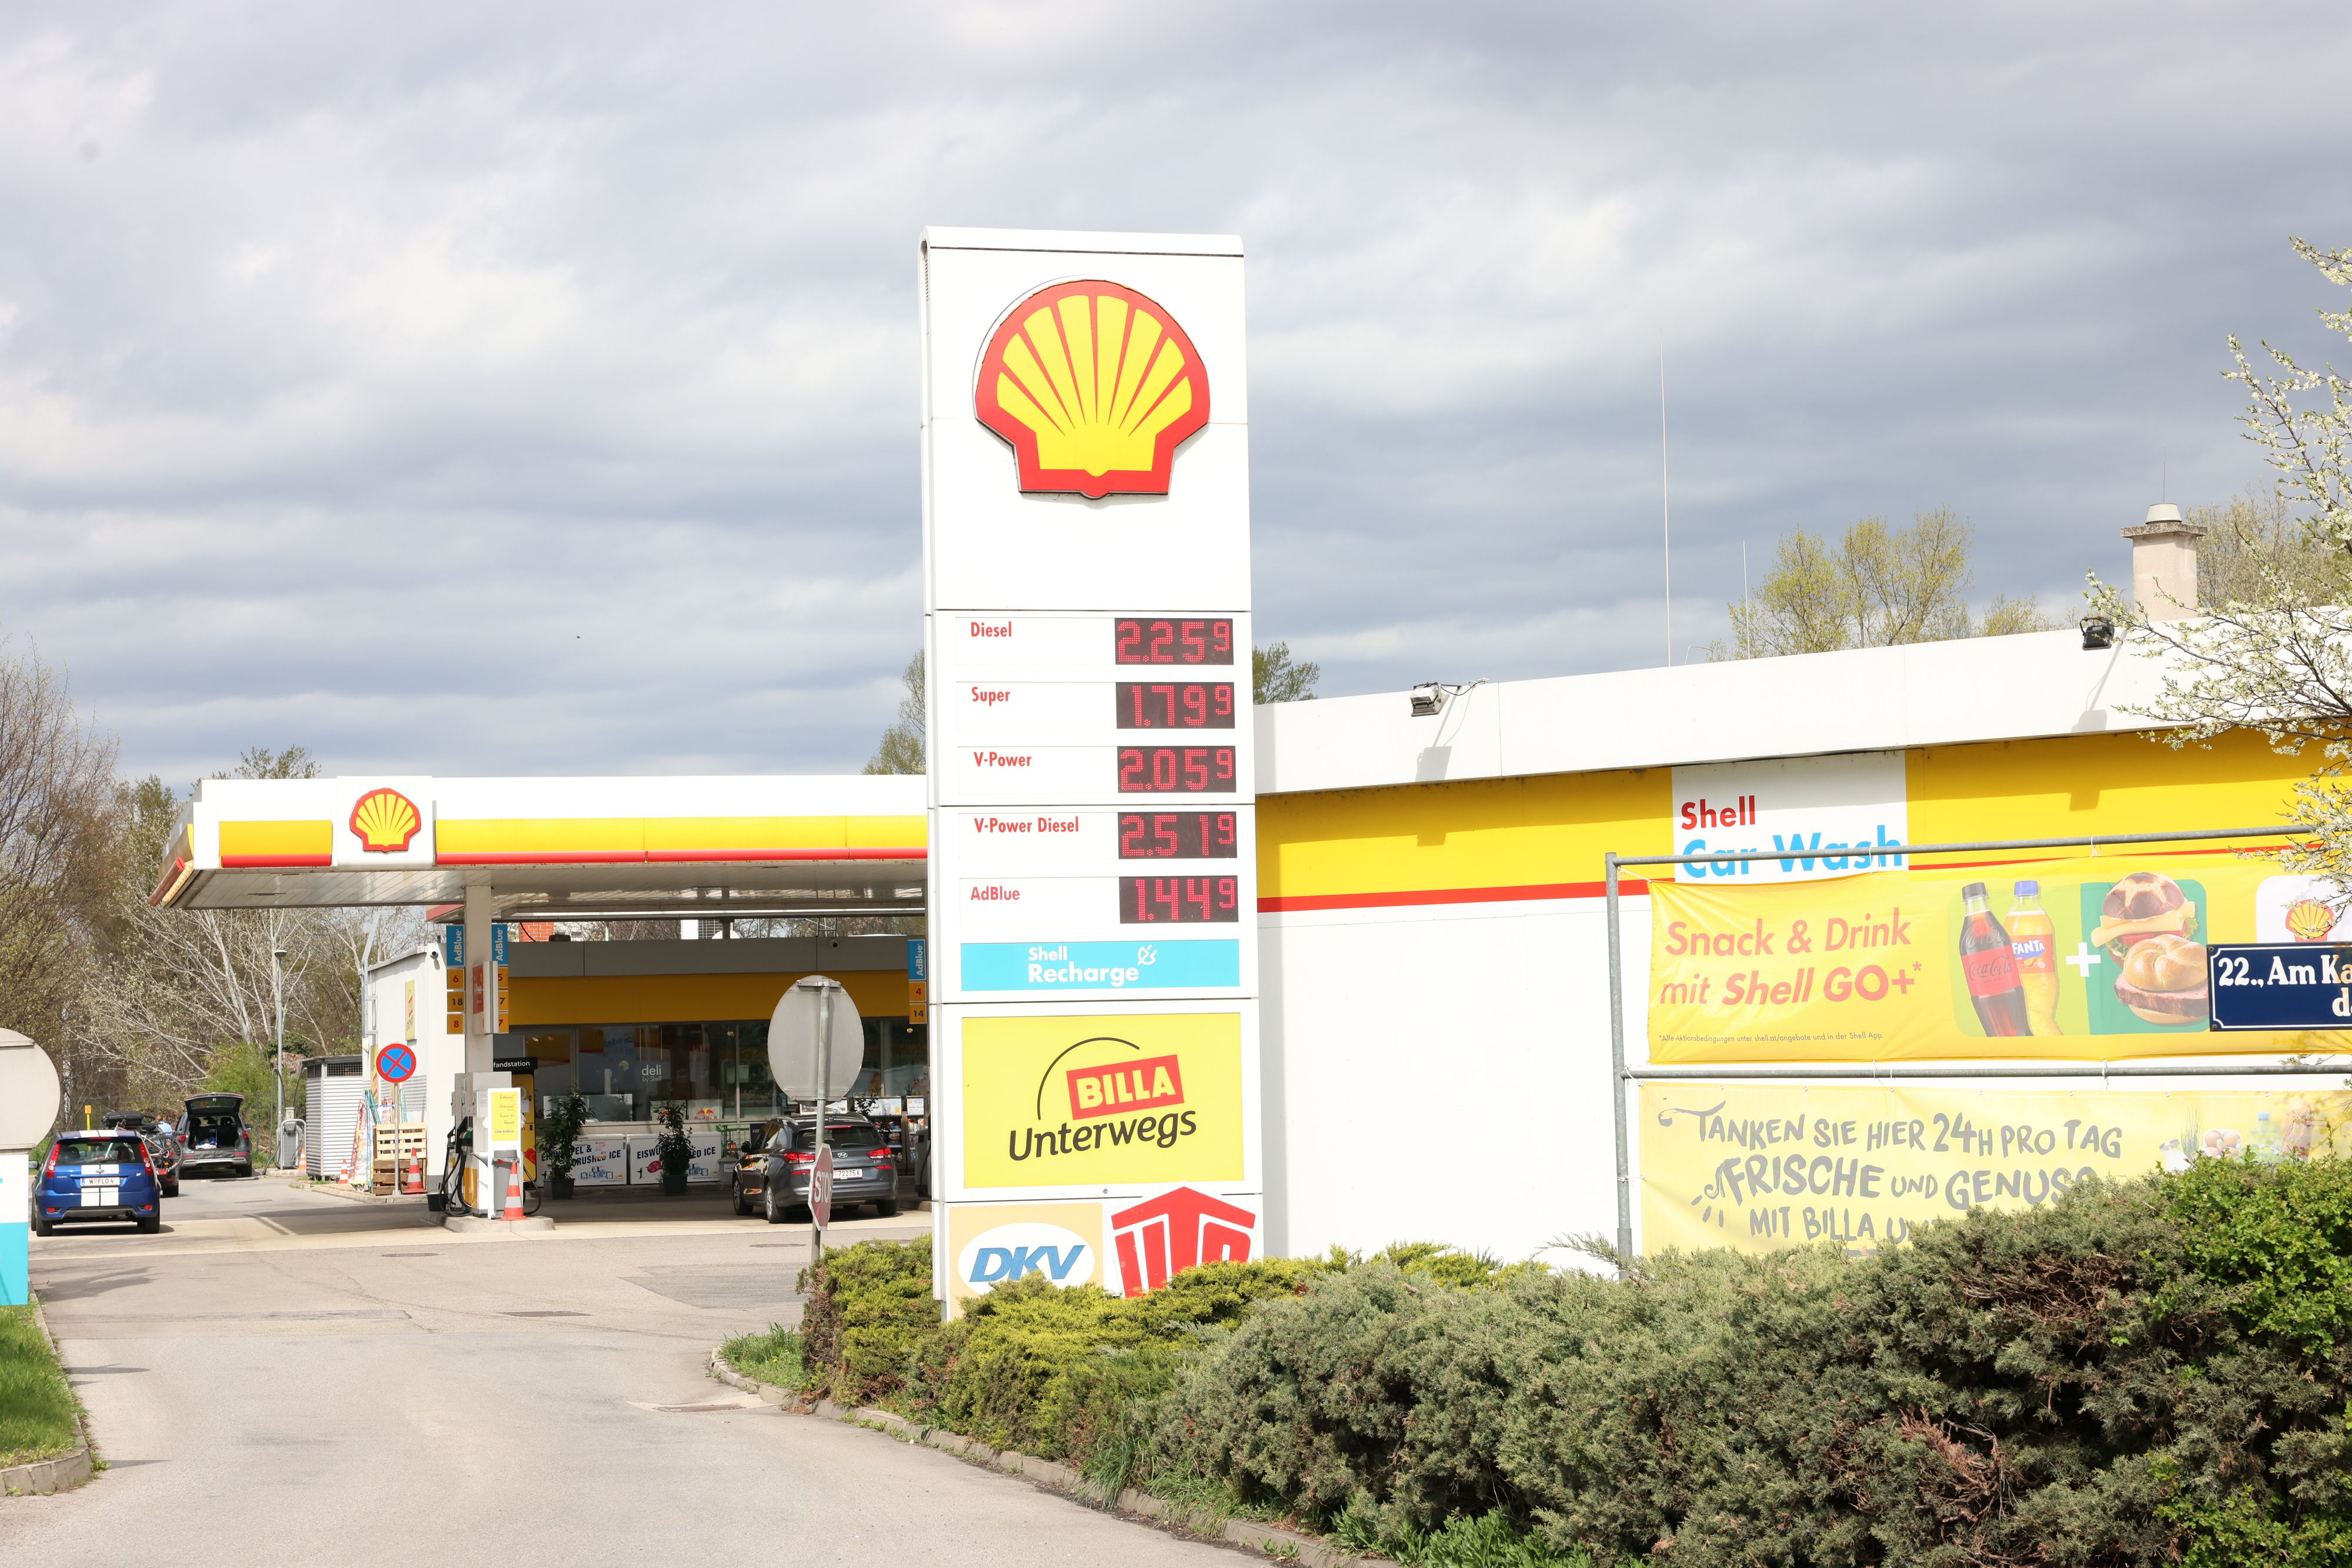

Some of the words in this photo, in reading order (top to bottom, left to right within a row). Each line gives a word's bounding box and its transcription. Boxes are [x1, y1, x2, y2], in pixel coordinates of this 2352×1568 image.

[971, 621, 1012, 637] Diesel
[1117, 621, 1230, 663] 2.259
[971, 687, 1011, 707] Super
[1131, 685, 1232, 727] 1.799
[974, 751, 1032, 768] V-Power
[1120, 748, 1233, 791] 2.059
[974, 818, 1033, 834] V-Power
[1038, 816, 1079, 833] Diesel
[1681, 795, 1756, 830] Shell
[1121, 814, 1234, 857] 2.519
[1682, 839, 1758, 878] Car
[1772, 824, 1903, 872] Wash
[970, 886, 1021, 901] AdBlue
[1135, 878, 1235, 921] 1.449
[1665, 917, 1776, 957] Snack
[1786, 920, 1812, 955] &
[1825, 907, 1912, 952] Drink
[2011, 939, 2045, 955] FANTA
[1028, 946, 1068, 961] Shell
[453, 975, 459, 983] 6
[1028, 961, 1140, 987] Recharge
[2267, 956, 2317, 986] Am
[1660, 973, 1711, 1005] mit
[1721, 967, 1815, 1006] Shell
[2332, 987, 2352, 1017] d
[1675, 1034, 1735, 1044] Aktionsbedingungen
[1754, 1034, 1811, 1043] shell.at/angebote
[1868, 1031, 1884, 1041] App.
[642, 1064, 662, 1075] deli
[1075, 1065, 1176, 1109] BILLA
[1008, 1110, 1197, 1162] Unterwegs
[1658, 1100, 1806, 1151] TANKEN
[1813, 1118, 1857, 1148] SIE
[1866, 1119, 1926, 1152] HIER
[2000, 1125, 2056, 1158] PRO
[2063, 1119, 2123, 1159] TAG
[586, 1144, 592, 1153] &
[609, 1149, 621, 1159] ICE
[704, 1146, 716, 1156] ICE
[1704, 1154, 1886, 1207] FRISCHE
[1891, 1174, 1938, 1199] UND
[1945, 1166, 2099, 1211] GENUS
[1749, 1206, 1790, 1239] MIT
[1802, 1206, 1875, 1242] BILLA
[969, 1244, 1085, 1282] DKV
